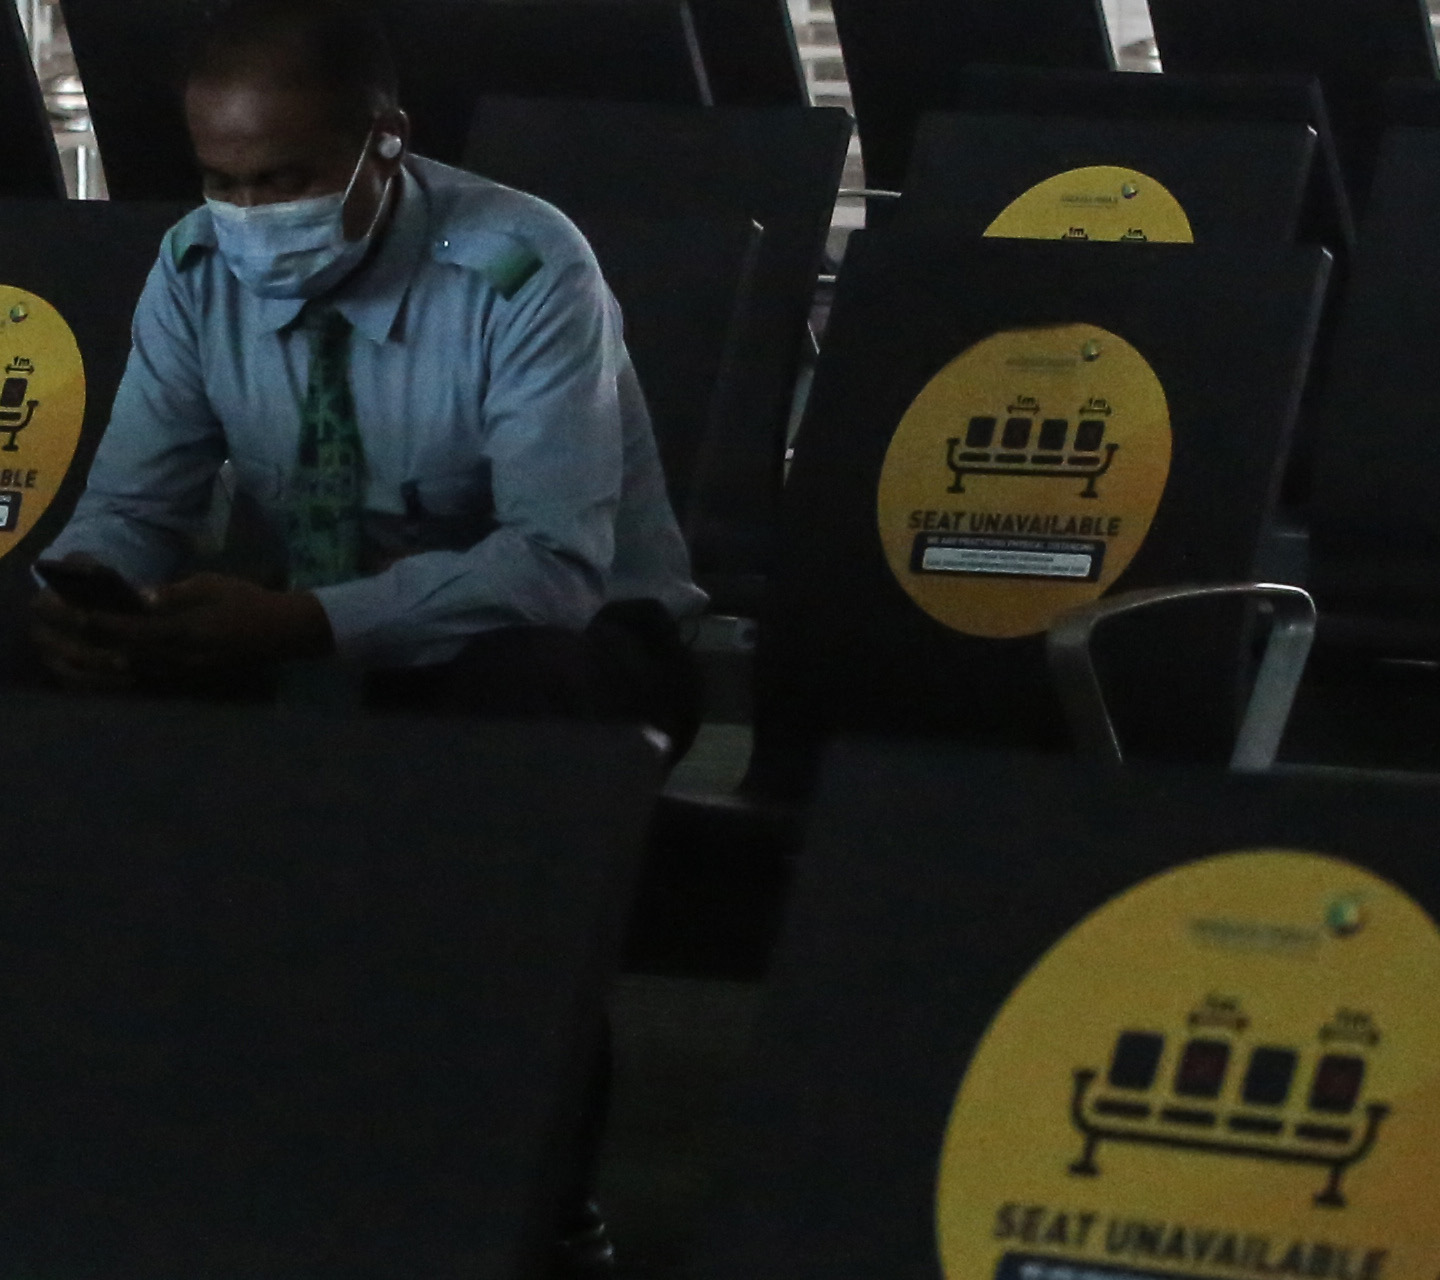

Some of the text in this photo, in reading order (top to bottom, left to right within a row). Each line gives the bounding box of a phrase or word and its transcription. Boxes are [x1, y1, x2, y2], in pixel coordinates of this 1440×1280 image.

[13, 356, 31, 368] 1m
[908, 510, 1123, 538] SEAT UNAVAILABLE
[994, 1200, 1096, 1246] SEAT
